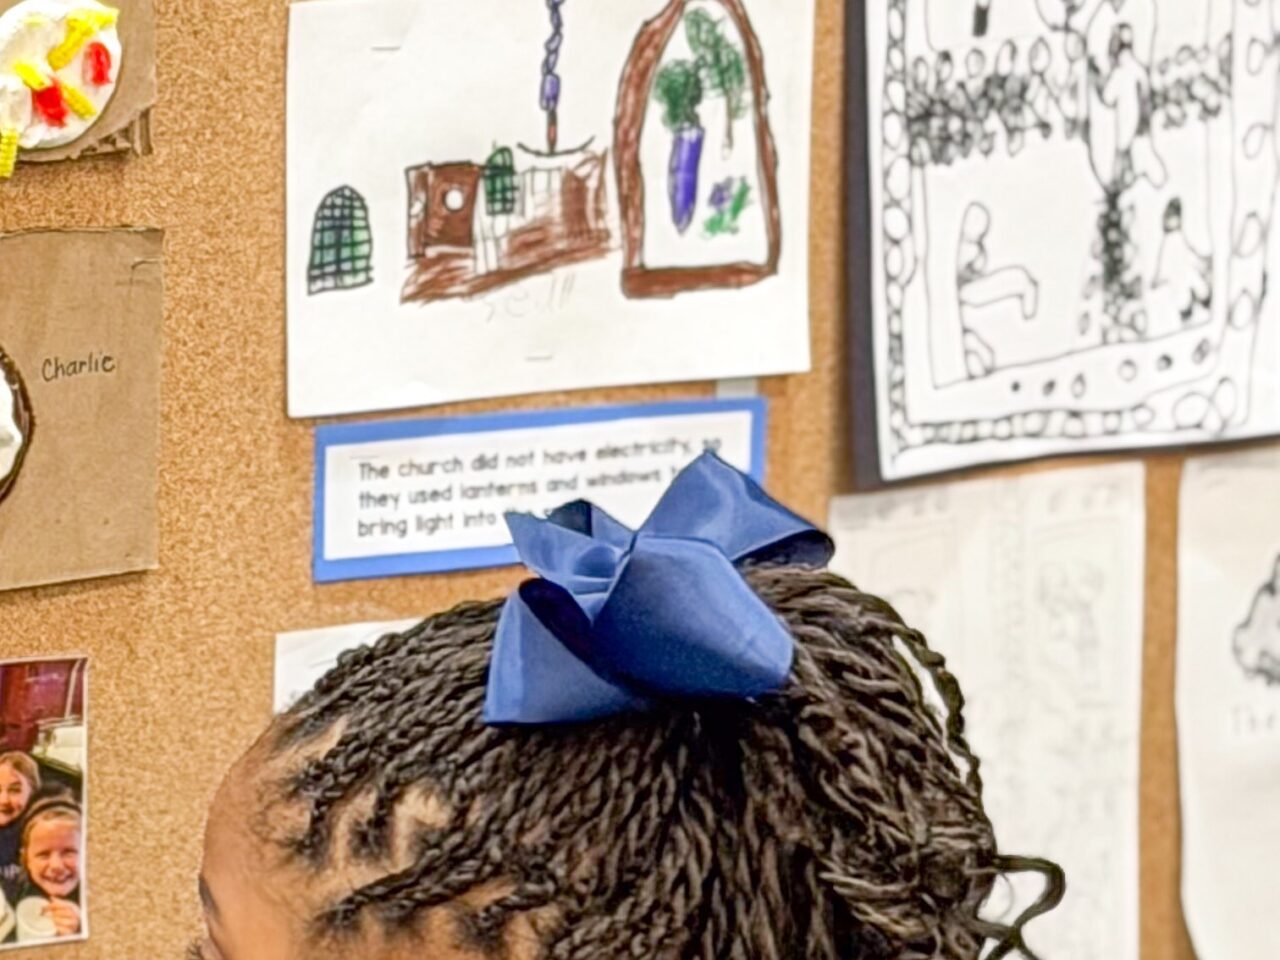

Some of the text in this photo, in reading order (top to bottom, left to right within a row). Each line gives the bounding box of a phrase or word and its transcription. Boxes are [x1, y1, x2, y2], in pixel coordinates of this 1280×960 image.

[41, 351, 116, 383] Charlie
[358, 462, 390, 481] The
[398, 457, 463, 477] church
[471, 453, 499, 471] did
[506, 451, 535, 468] not
[543, 449, 587, 465] have
[358, 491, 401, 511] they
[408, 486, 453, 505] used
[461, 481, 538, 500] lanterns
[547, 475, 578, 493] and
[586, 468, 661, 488] windows
[357, 518, 408, 539] bring
[416, 513, 454, 535] light
[463, 511, 497, 528] into
